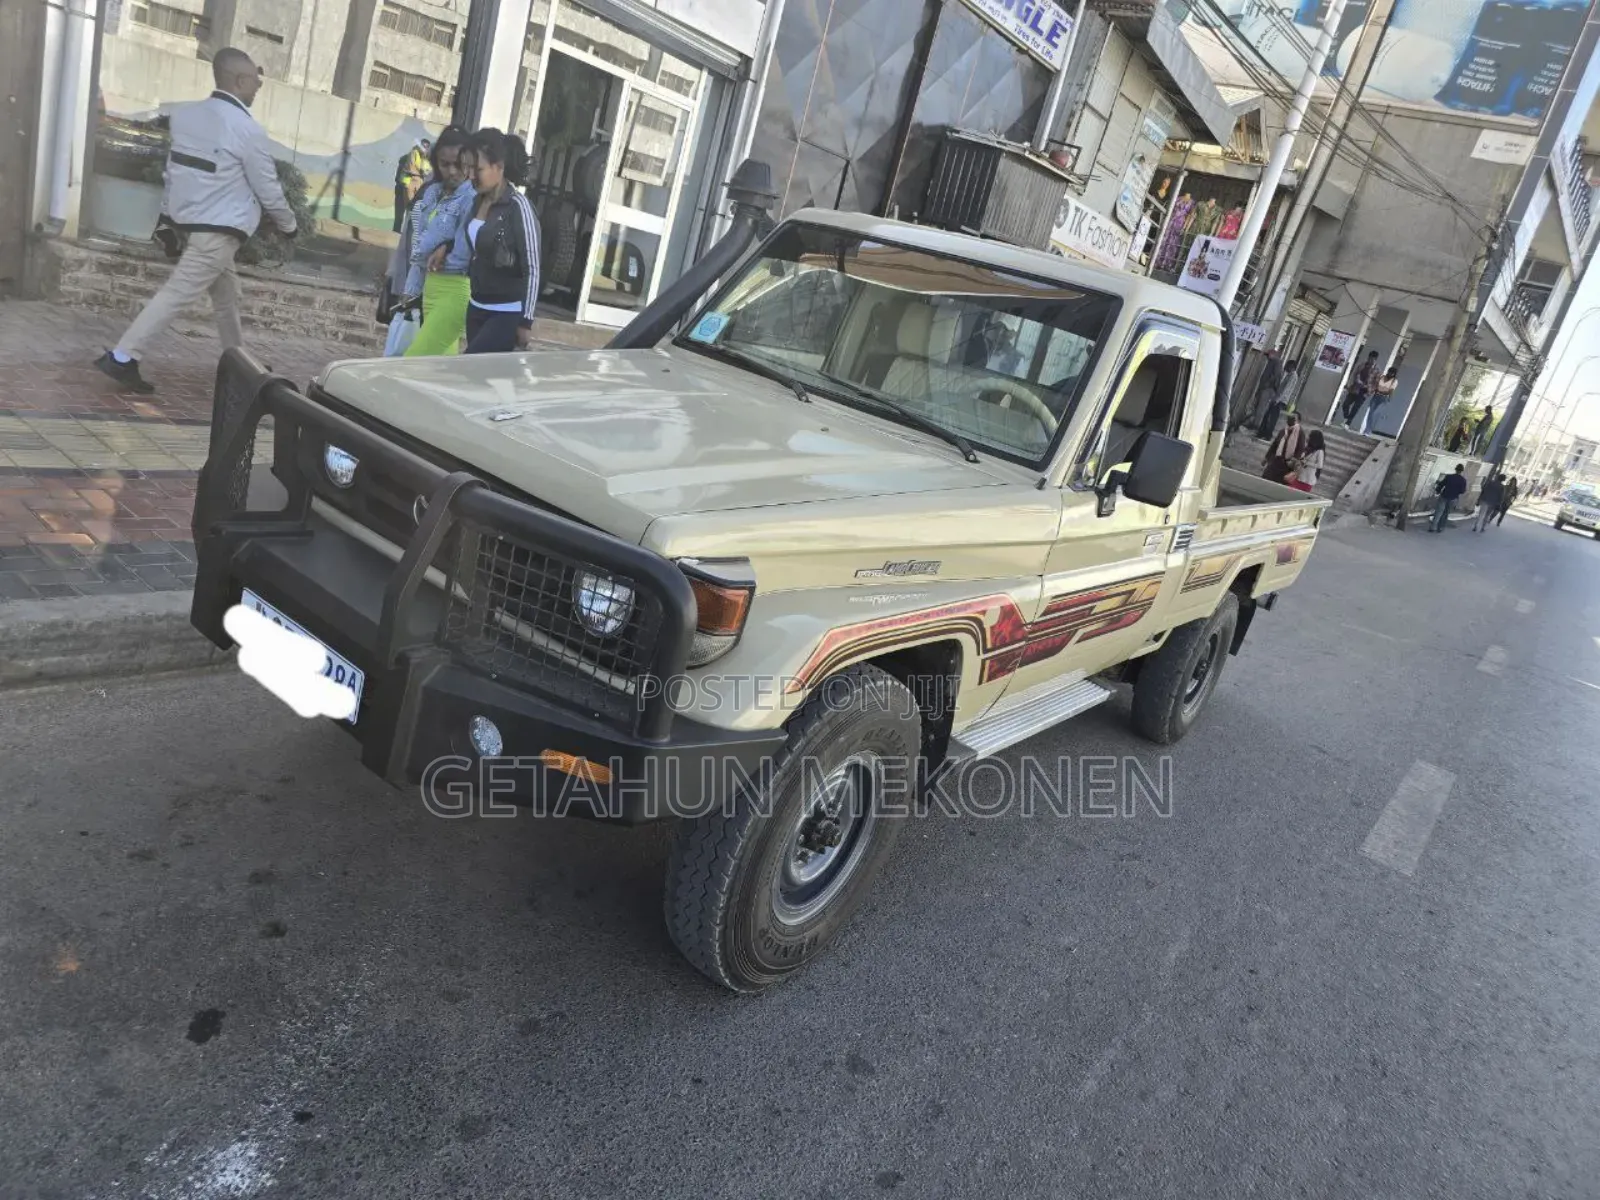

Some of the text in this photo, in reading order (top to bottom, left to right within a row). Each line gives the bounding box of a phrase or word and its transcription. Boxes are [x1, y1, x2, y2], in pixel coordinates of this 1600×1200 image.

[1014, 24, 1030, 41] Tires
[1030, 37, 1041, 49] for
[1069, 204, 1088, 239] TK
[1085, 215, 1129, 258] Fashion
